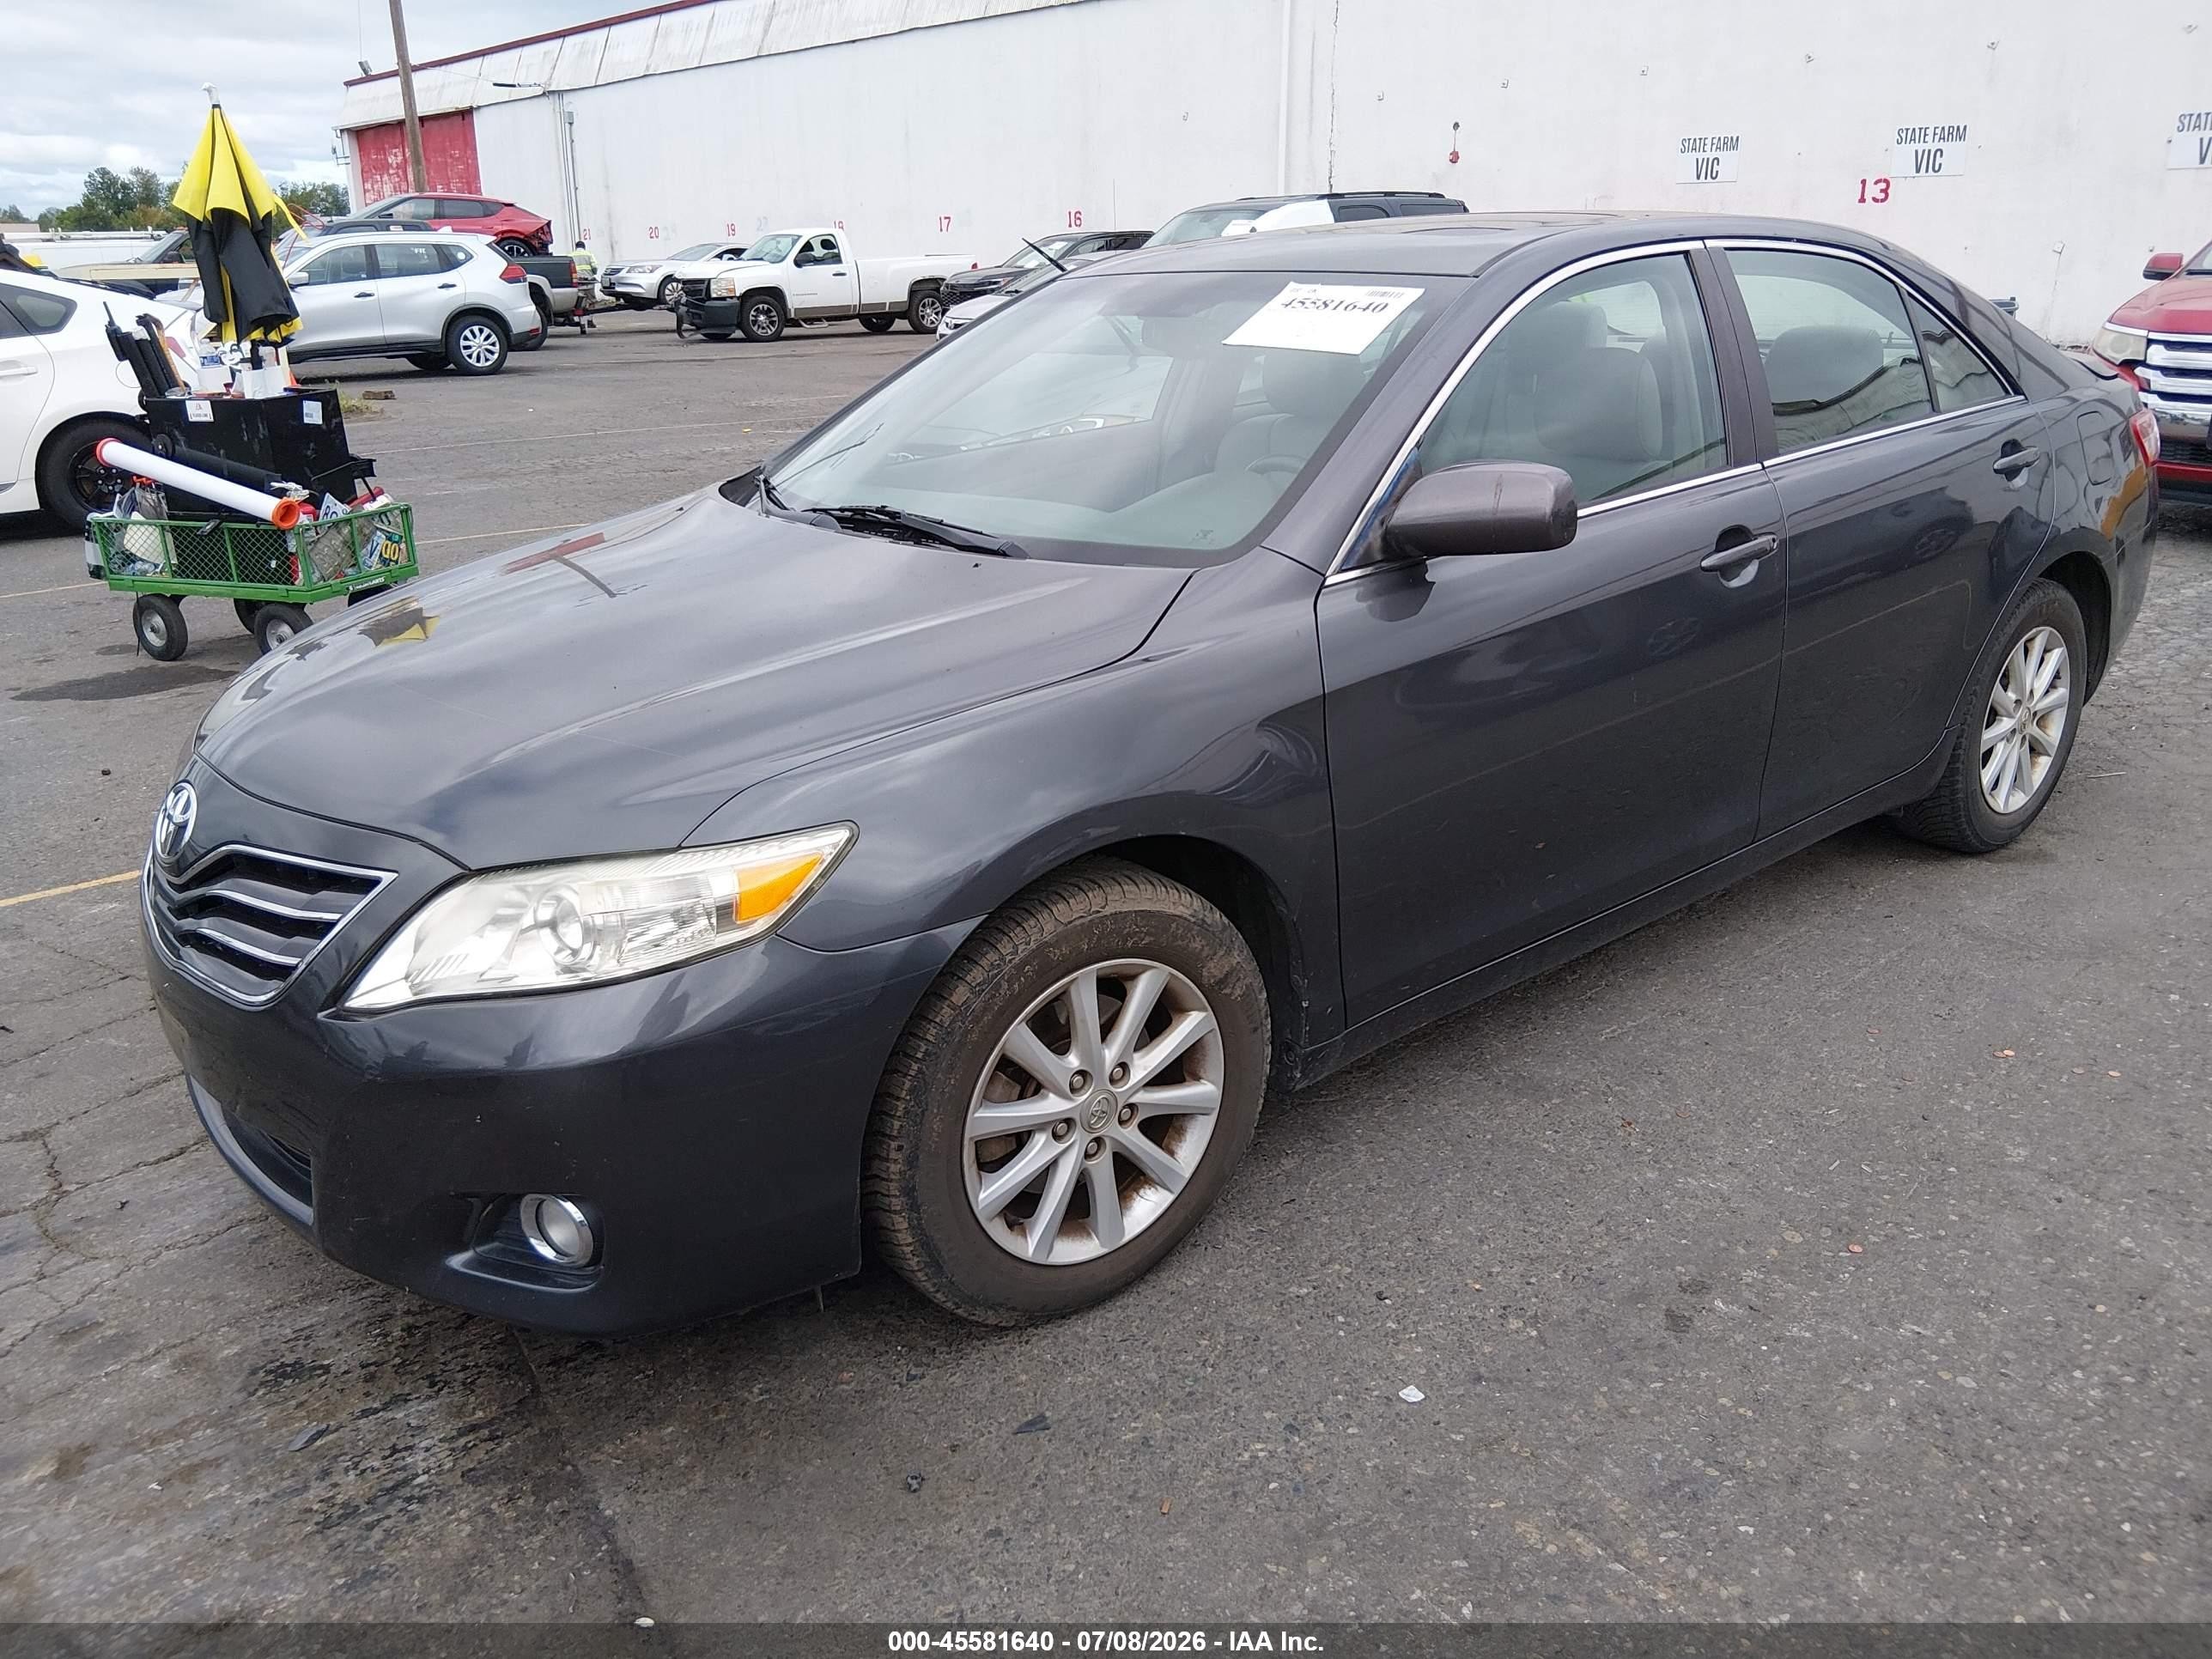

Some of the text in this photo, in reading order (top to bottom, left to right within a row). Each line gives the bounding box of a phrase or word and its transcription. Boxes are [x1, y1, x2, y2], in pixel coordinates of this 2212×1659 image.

[2177, 112, 2212, 132] STAT
[1896, 125, 1967, 145] STATE FARM
[1680, 136, 1740, 154] STATE FARM
[1695, 156, 1720, 181] VIC
[1914, 148, 1944, 174] VIC
[1857, 178, 1892, 204] 13
[939, 216, 951, 233] 17
[1067, 210, 1083, 228] 16
[582, 228, 592, 240] 21
[648, 226, 659, 239] 20
[726, 222, 736, 237] 19
[1281, 298, 1389, 314] 45581640
